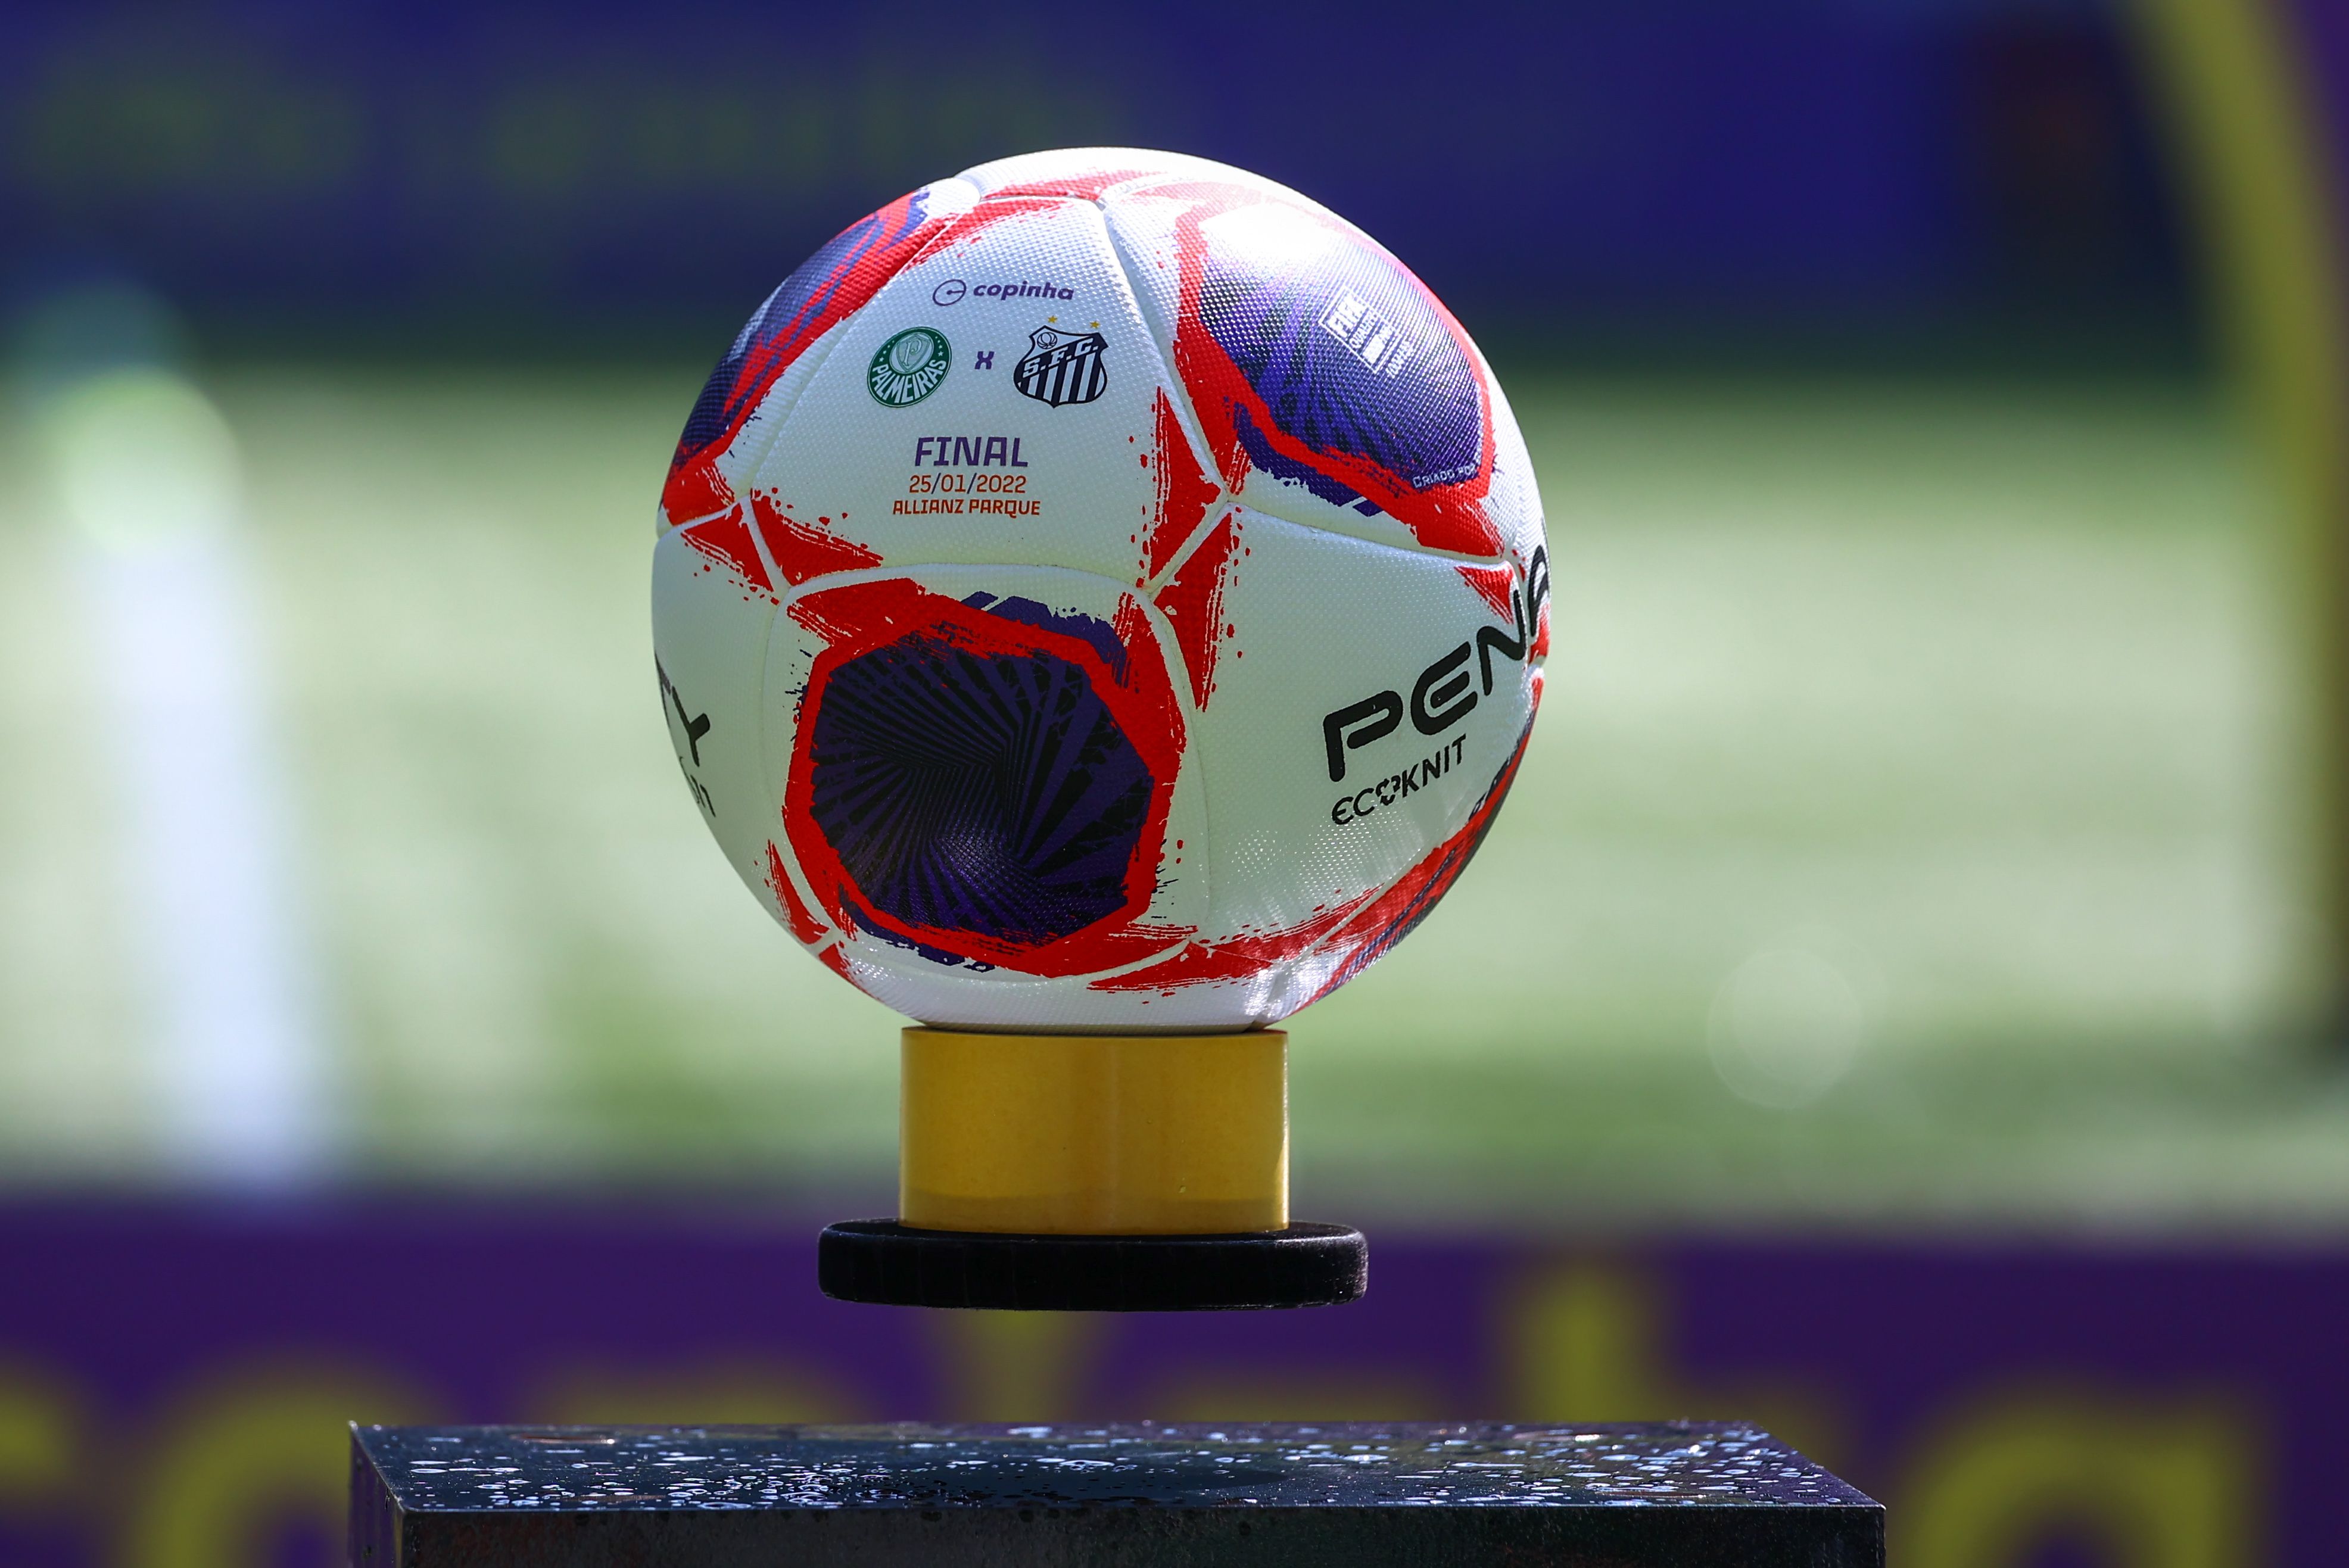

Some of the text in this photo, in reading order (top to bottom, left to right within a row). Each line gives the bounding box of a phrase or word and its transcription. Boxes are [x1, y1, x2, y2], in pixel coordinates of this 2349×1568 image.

[973, 280, 1074, 301] copinha
[1326, 292, 1370, 338] FIFA
[1022, 337, 1099, 379] S.F.C.
[871, 359, 947, 404] PALMEIRAS
[914, 437, 1029, 467] FINAL
[909, 472, 1027, 495] 25/01/2022
[892, 498, 1041, 519] ALLIANZ PARQUE
